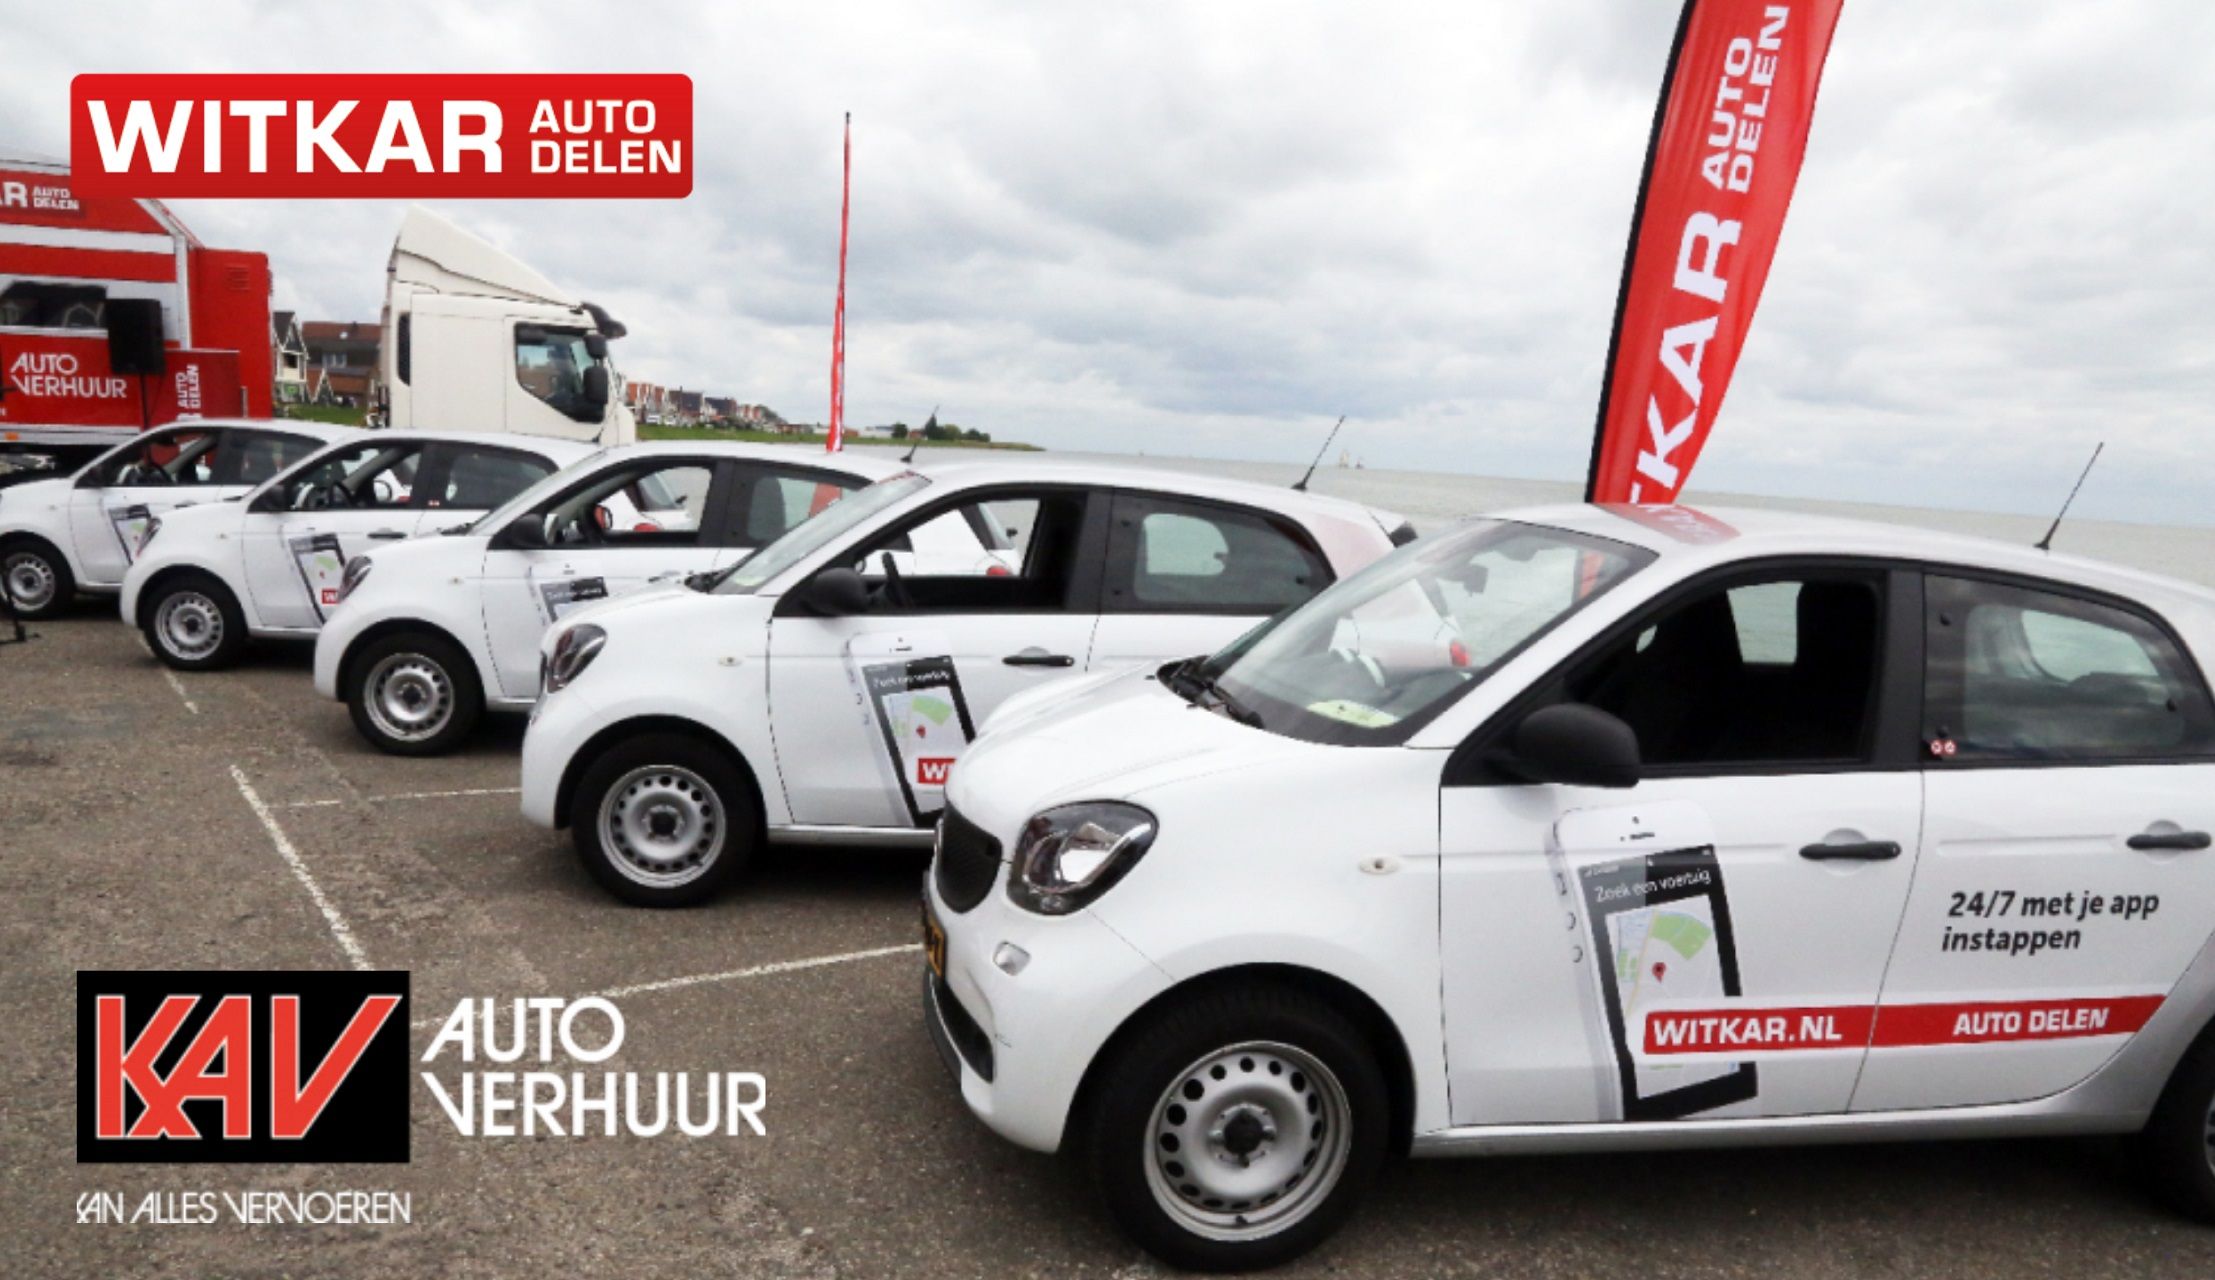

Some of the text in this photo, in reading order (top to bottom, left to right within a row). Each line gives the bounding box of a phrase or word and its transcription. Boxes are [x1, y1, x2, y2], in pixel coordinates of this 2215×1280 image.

[1702, 37, 1752, 190] AUTO
[1727, 5, 1790, 193] DELEN
[0, 181, 27, 208] R
[32, 186, 71, 199] AUTO
[33, 197, 80, 210] DELEN
[11, 353, 78, 374] AUTO
[12, 375, 127, 398] VERHUUR
[1948, 890, 2160, 922] 24/7 met je app
[1942, 926, 2082, 956] instappen
[1653, 1015, 1844, 1046] WITKAR.NL
[1953, 1007, 2110, 1036] AUTO DELEN
